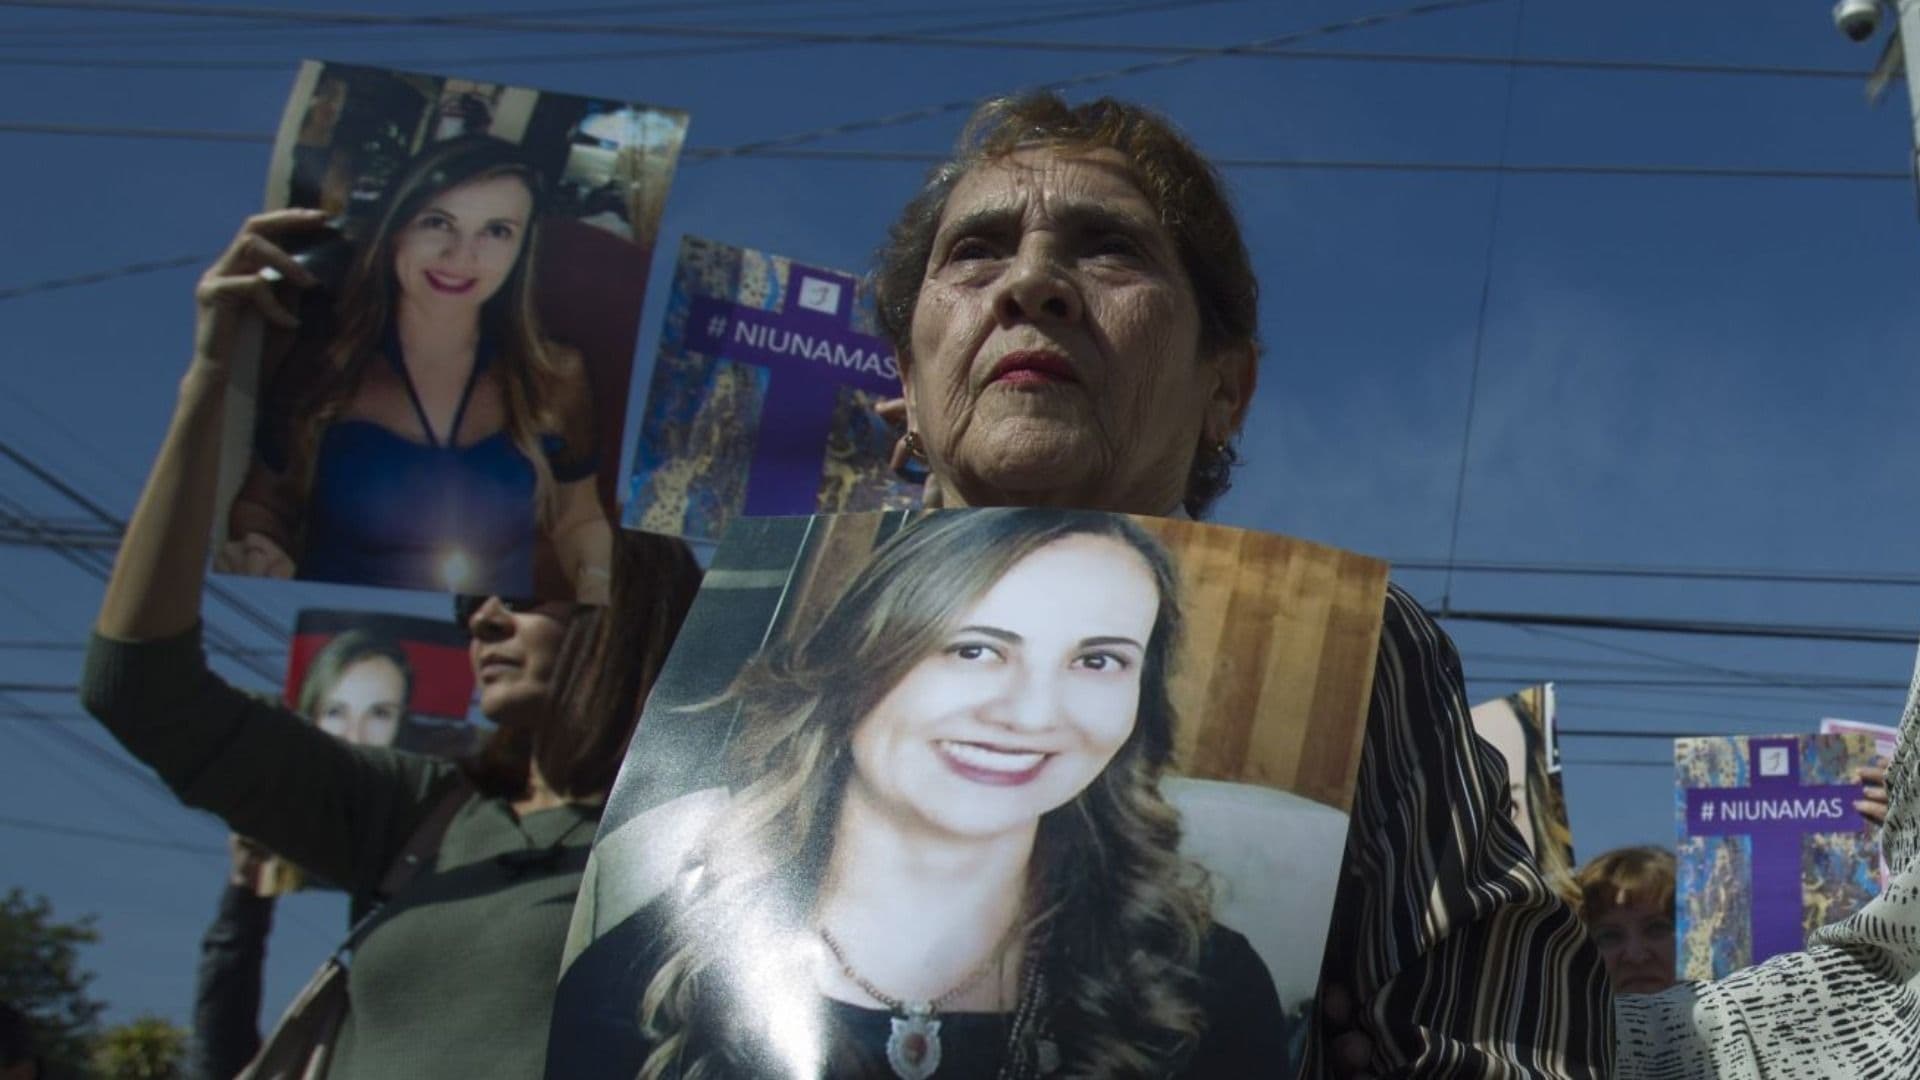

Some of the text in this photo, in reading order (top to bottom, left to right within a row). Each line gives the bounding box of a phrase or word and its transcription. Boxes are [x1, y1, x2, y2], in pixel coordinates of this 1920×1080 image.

[707, 315, 898, 379] # NIUNAMAS
[1701, 798, 1843, 820] # NIUNAMAS
